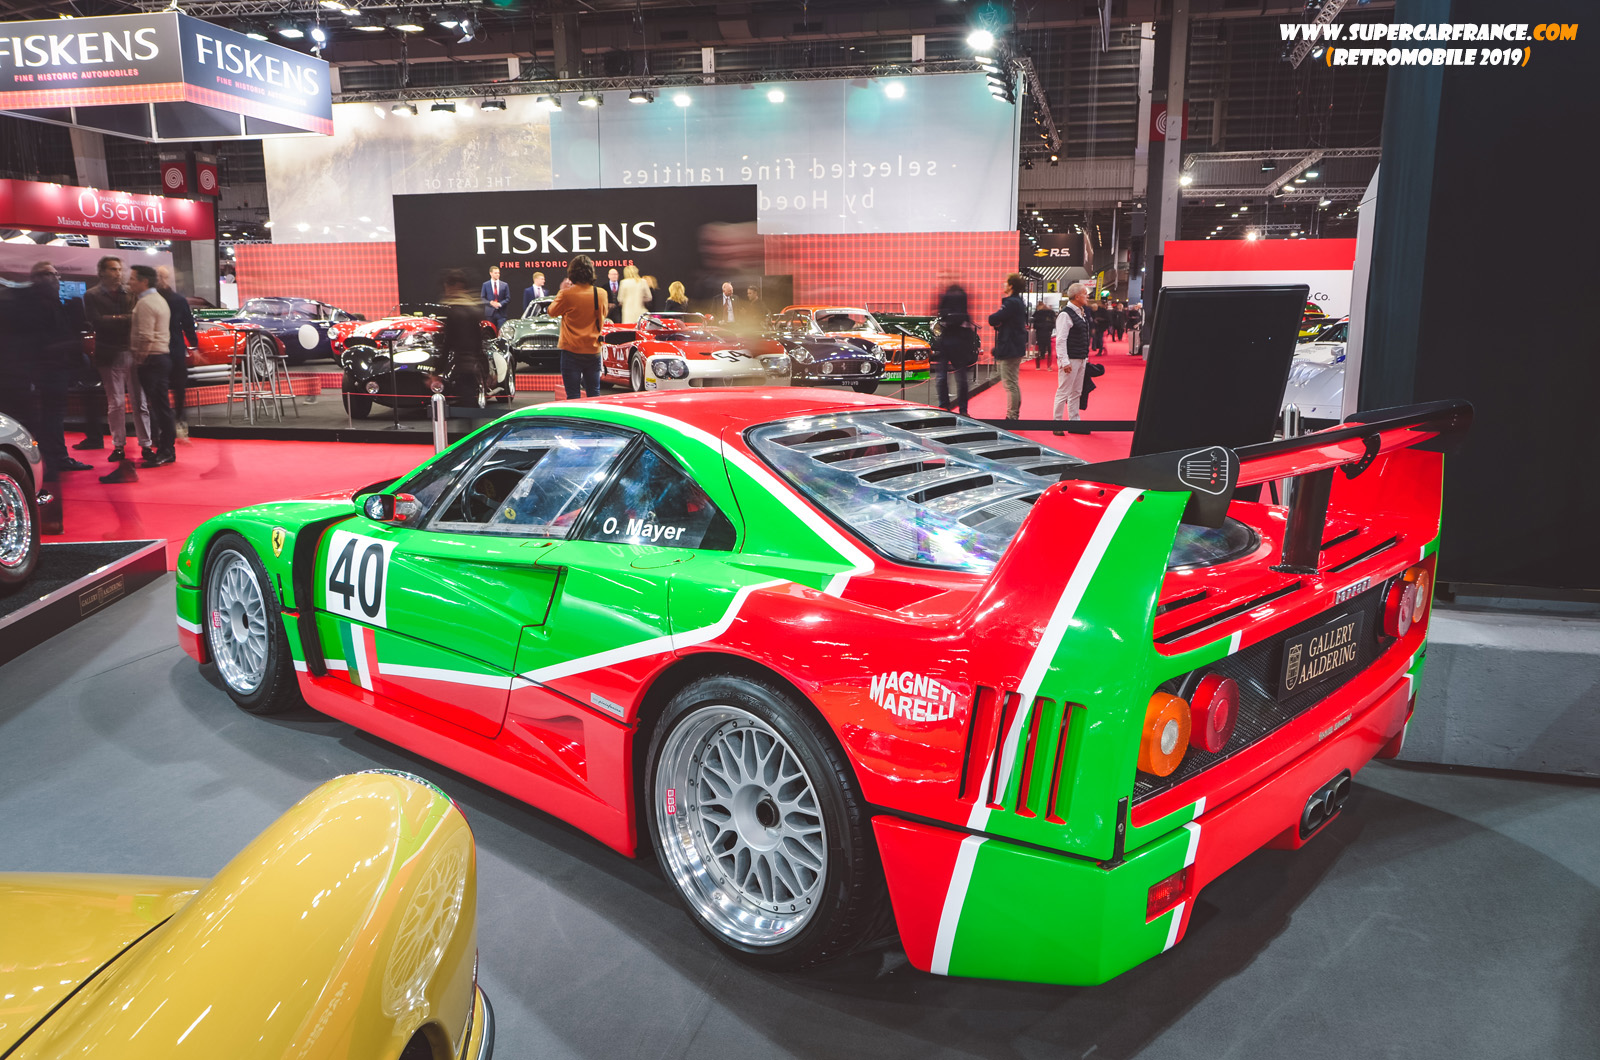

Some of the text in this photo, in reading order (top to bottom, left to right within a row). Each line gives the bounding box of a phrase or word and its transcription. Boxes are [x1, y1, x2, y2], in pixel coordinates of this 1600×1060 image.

[14, 68, 139, 82] FINE HISTORIC AUTOMOBILES
[195, 33, 320, 96] FISKENS
[78, 190, 166, 224] Osenat
[56, 216, 81, 227] Maison
[82, 219, 91, 228] de
[91, 221, 109, 229] ventes
[121, 223, 145, 232] enchères
[150, 224, 171, 234] Auction
[171, 227, 187, 235] house
[475, 220, 658, 255] FISKENS
[500, 261, 520, 269] FINE
[525, 260, 568, 268] HISTORIC
[1314, 292, 1330, 301] Co.
[602, 516, 686, 543] O. Mayer
[328, 537, 384, 619] 40
[1309, 622, 1355, 657] GALLERY
[1298, 642, 1357, 685] AALDERING
[870, 671, 956, 717] MAGNETI
[870, 675, 956, 722] MARELLI
